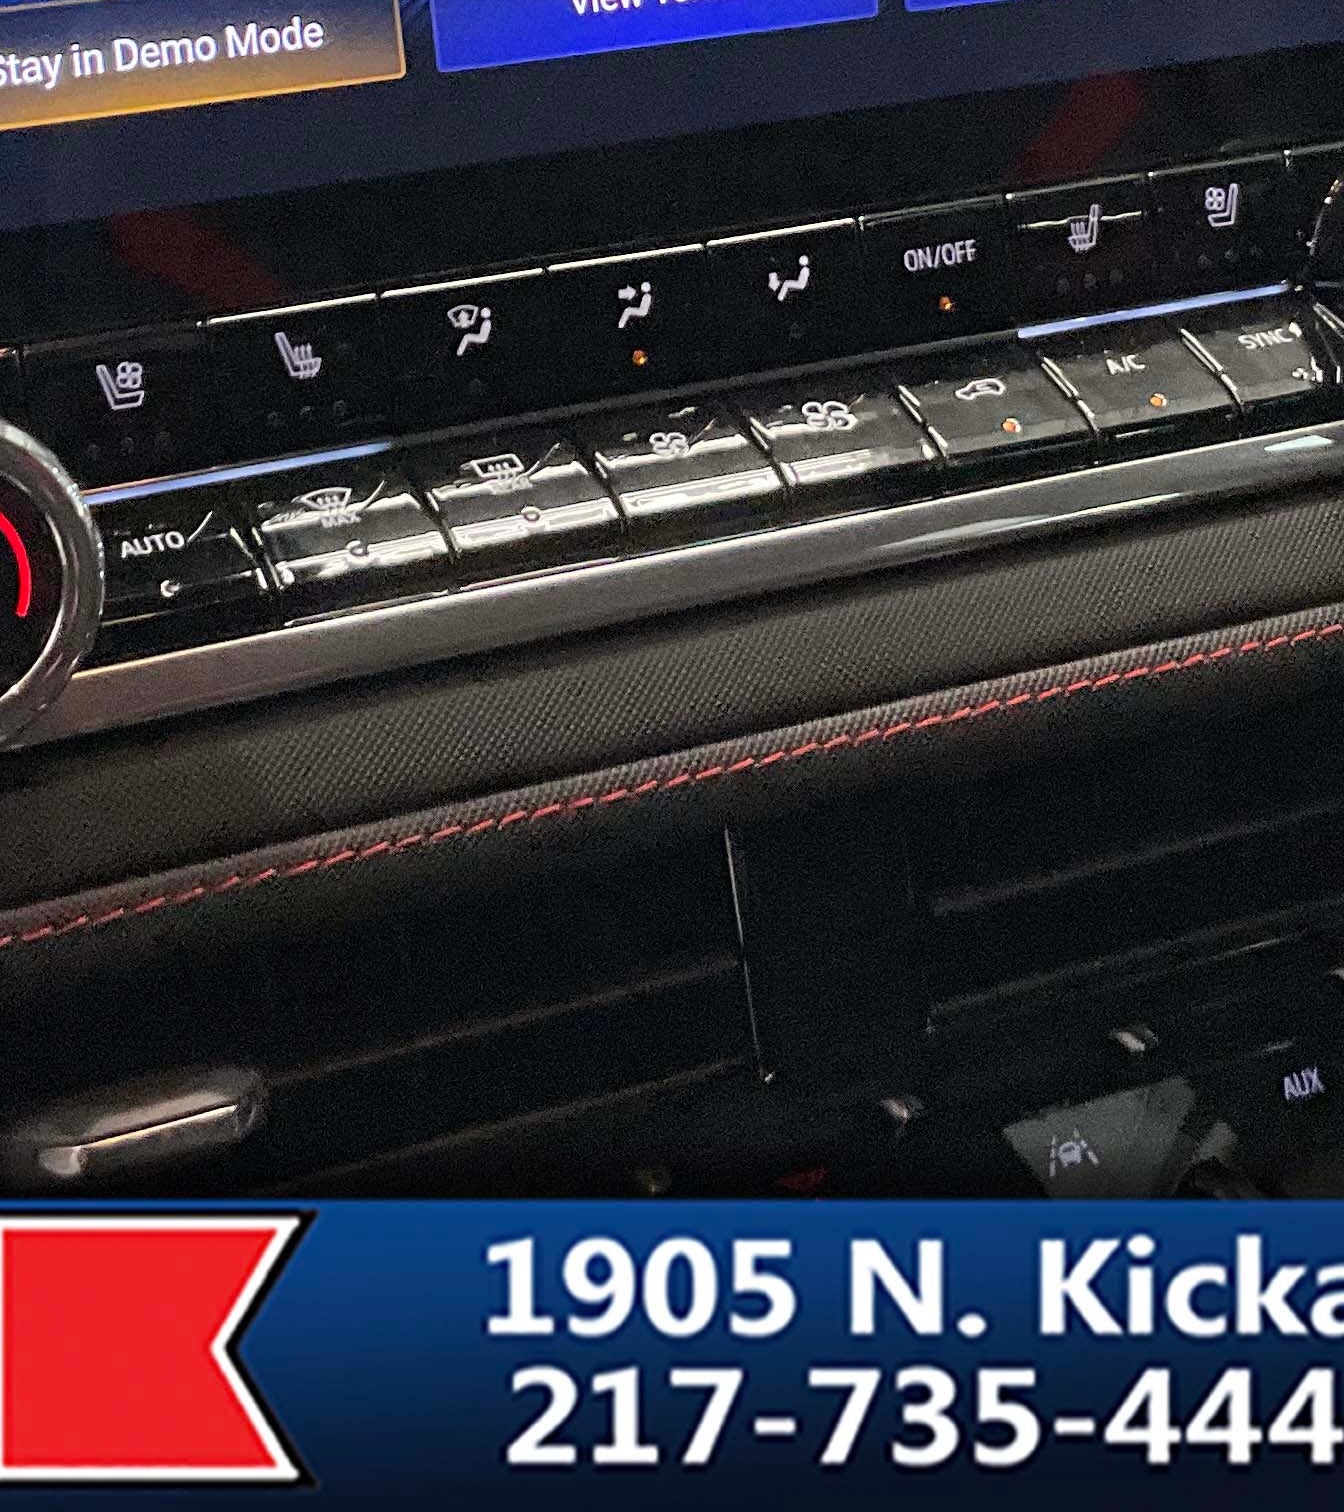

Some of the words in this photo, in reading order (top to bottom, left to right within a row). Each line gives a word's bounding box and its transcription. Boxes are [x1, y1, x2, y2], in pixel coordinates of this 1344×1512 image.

[73, 43, 104, 78] in
[113, 33, 216, 72] Demo
[225, 20, 325, 61] Mode
[903, 239, 978, 272] ON/OFF
[1237, 326, 1292, 350] SYNC
[1105, 354, 1146, 374] A/C
[120, 531, 185, 557] AUTO
[1284, 1066, 1325, 1100] AUX
